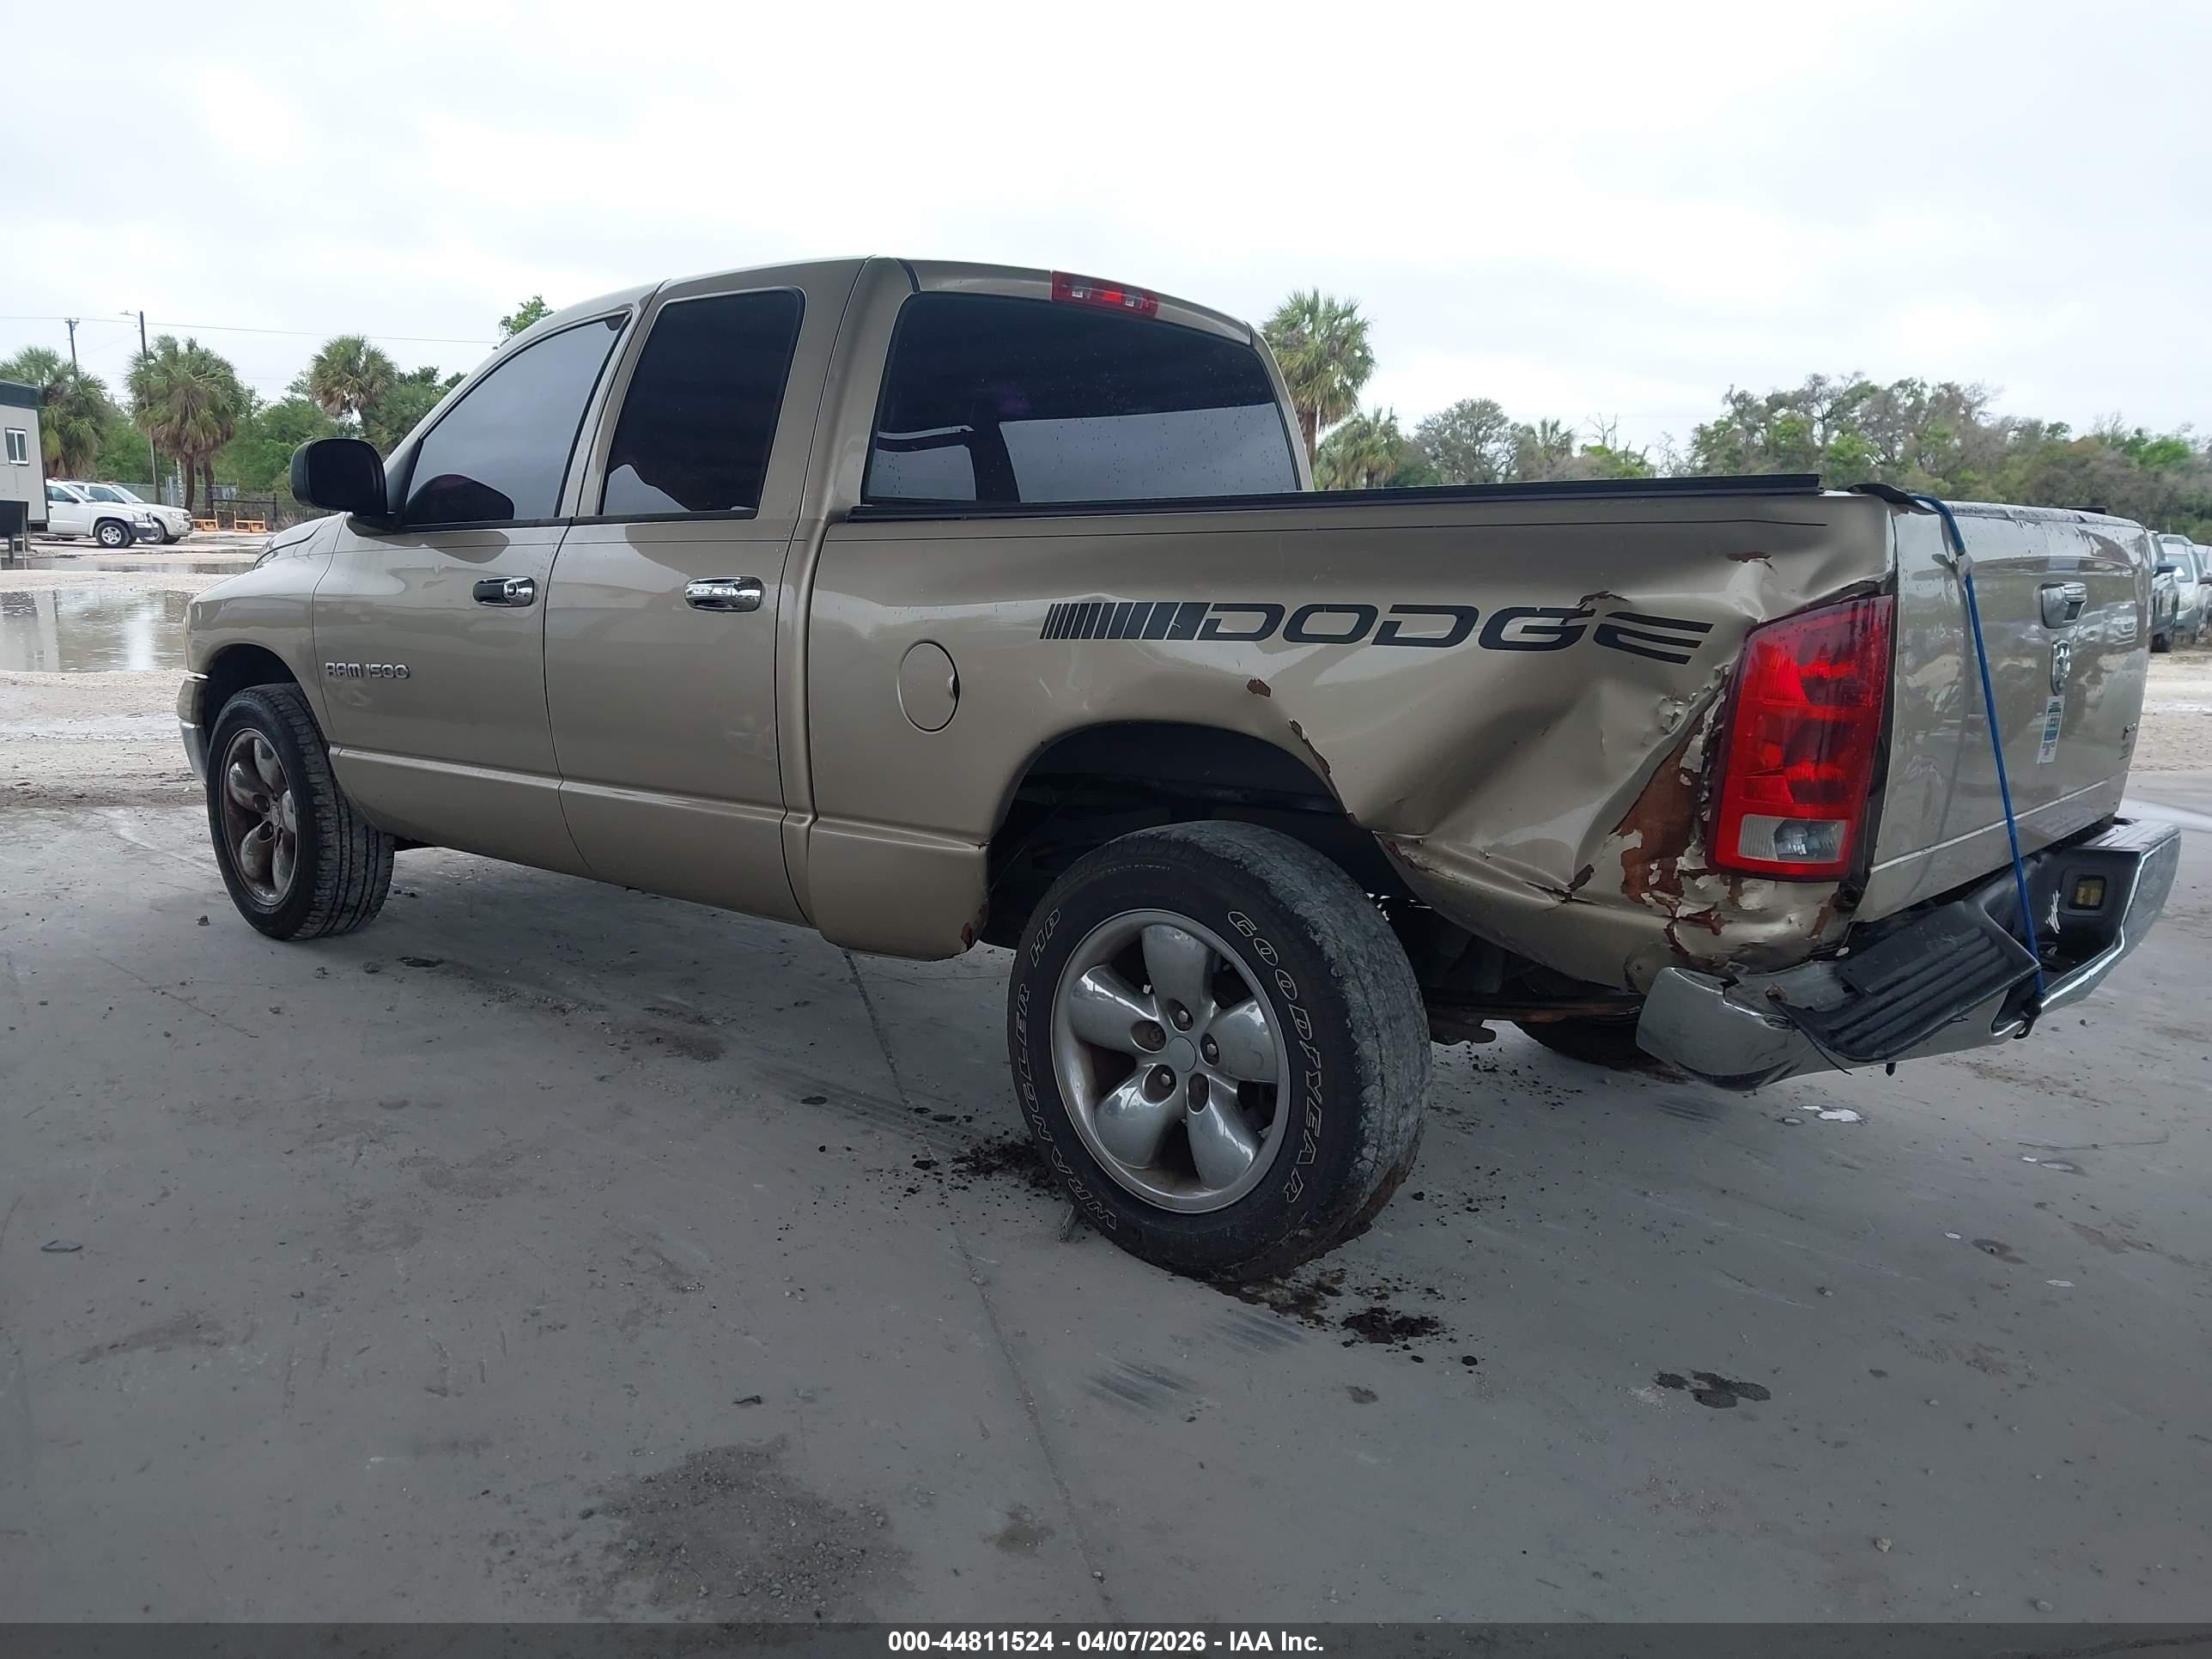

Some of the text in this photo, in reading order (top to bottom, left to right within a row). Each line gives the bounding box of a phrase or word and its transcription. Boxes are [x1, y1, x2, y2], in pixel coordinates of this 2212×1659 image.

[325, 662, 410, 679] RAM 1500
[1197, 602, 1715, 665] DODGE
[1017, 907, 1116, 1230] WRANGLER HP
[1228, 910, 1322, 1203] GOODYEAR
